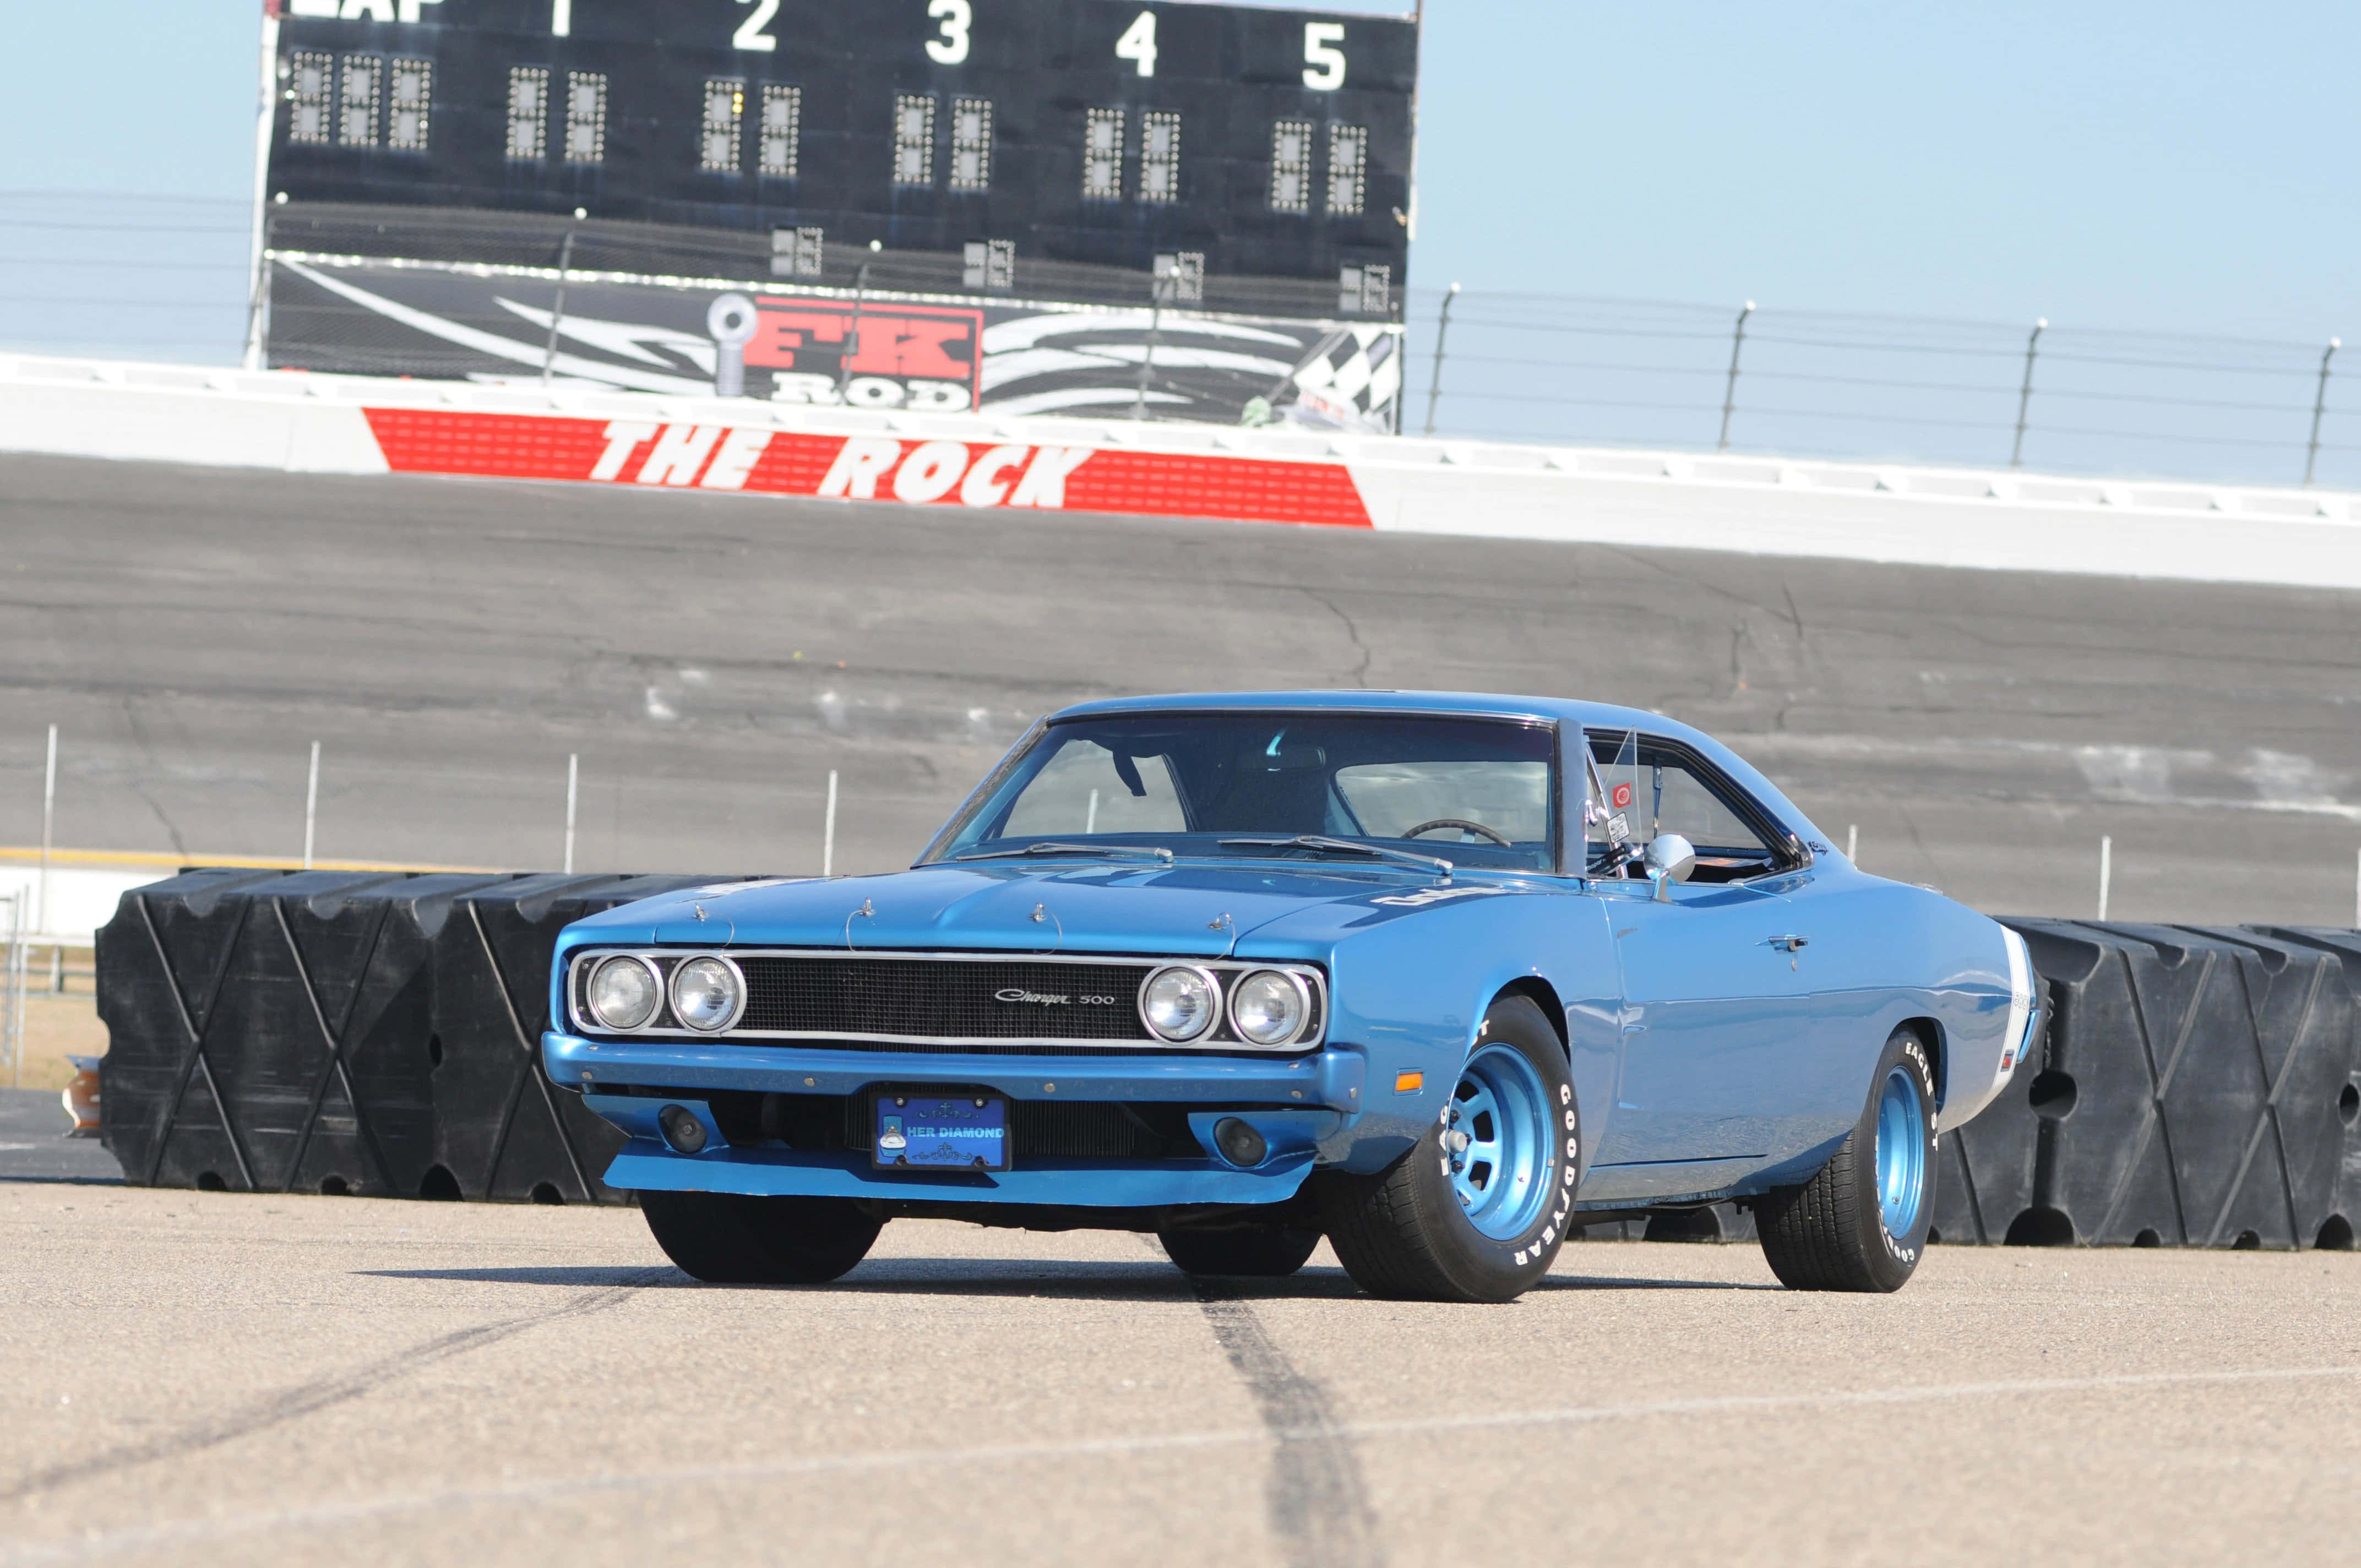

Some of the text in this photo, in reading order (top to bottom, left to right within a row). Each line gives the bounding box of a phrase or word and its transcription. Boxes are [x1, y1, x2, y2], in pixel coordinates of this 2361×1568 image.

[732, 0, 777, 51] 2
[925, 0, 972, 64] 3
[1116, 10, 1157, 77] 4
[1302, 23, 1346, 91] 5
[743, 309, 971, 379] FK
[771, 371, 971, 412] ROD
[589, 420, 1097, 509] THE ROCK
[995, 988, 1115, 1006] Charger 500
[907, 1127, 1005, 1138] HER DIAMOND
[1905, 1042, 1938, 1151] EAGLE ST
[1514, 1084, 1577, 1266] GOODYEAR
